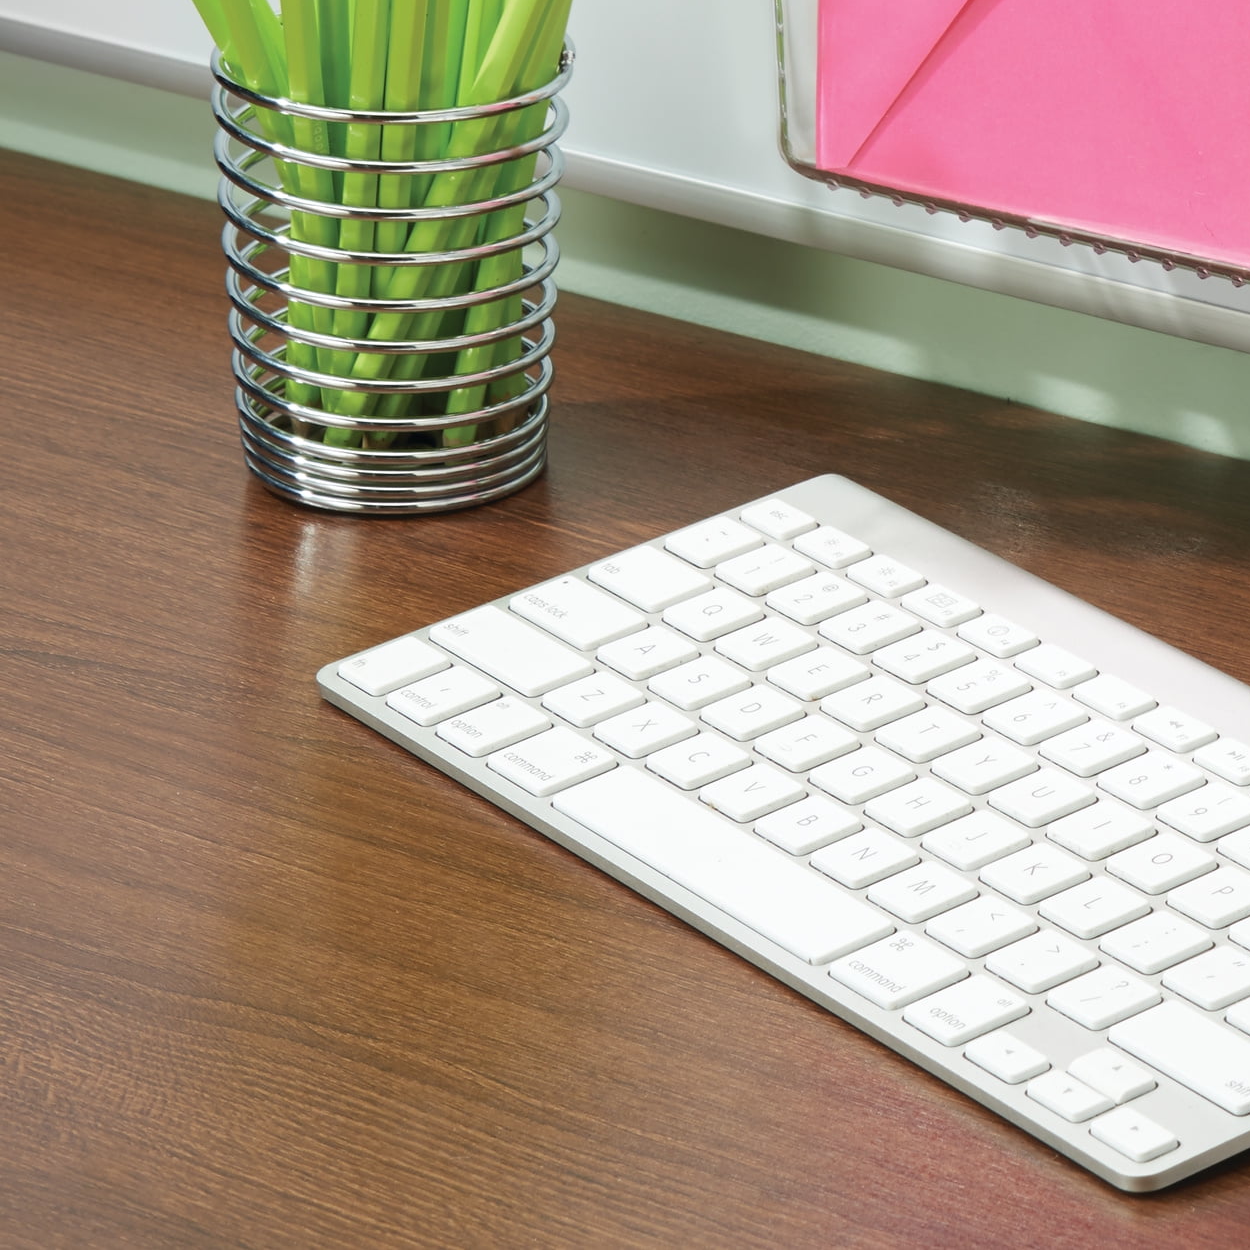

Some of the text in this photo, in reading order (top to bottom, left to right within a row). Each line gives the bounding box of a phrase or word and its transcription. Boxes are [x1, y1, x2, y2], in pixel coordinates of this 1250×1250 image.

[601, 563, 621, 575] tab
[793, 594, 814, 604] 2
[523, 592, 569, 620] caps lock
[701, 604, 724, 617] Q
[443, 622, 469, 638] shift
[847, 622, 867, 632] 3
[751, 632, 779, 647] W
[634, 644, 657, 655] A
[903, 653, 921, 662] 4
[807, 663, 830, 675] E
[687, 673, 710, 684] S
[956, 681, 977, 691] 5
[400, 687, 437, 710] control
[580, 689, 605, 702] Z
[861, 693, 884, 705] R
[739, 702, 763, 714] D
[1013, 713, 1032, 723] 6
[450, 719, 483, 738] option
[631, 718, 657, 732] X
[919, 723, 941, 734] T
[794, 733, 818, 743] F
[1070, 742, 1092, 751] 7
[687, 751, 711, 763] C
[975, 754, 997, 766] Y
[503, 751, 556, 782] command
[851, 765, 875, 777] G
[1128, 775, 1149, 786] 8
[743, 781, 766, 793] V
[1031, 785, 1056, 799] U
[905, 795, 932, 810] H
[1188, 807, 1209, 816] 9
[795, 814, 819, 827] B
[964, 832, 988, 842] J
[851, 846, 878, 861] N
[1023, 862, 1049, 876] K
[907, 880, 937, 896] M
[1211, 885, 1235, 895] P
[1083, 896, 1102, 910] L
[848, 958, 906, 993] command
[929, 1007, 967, 1030] option
